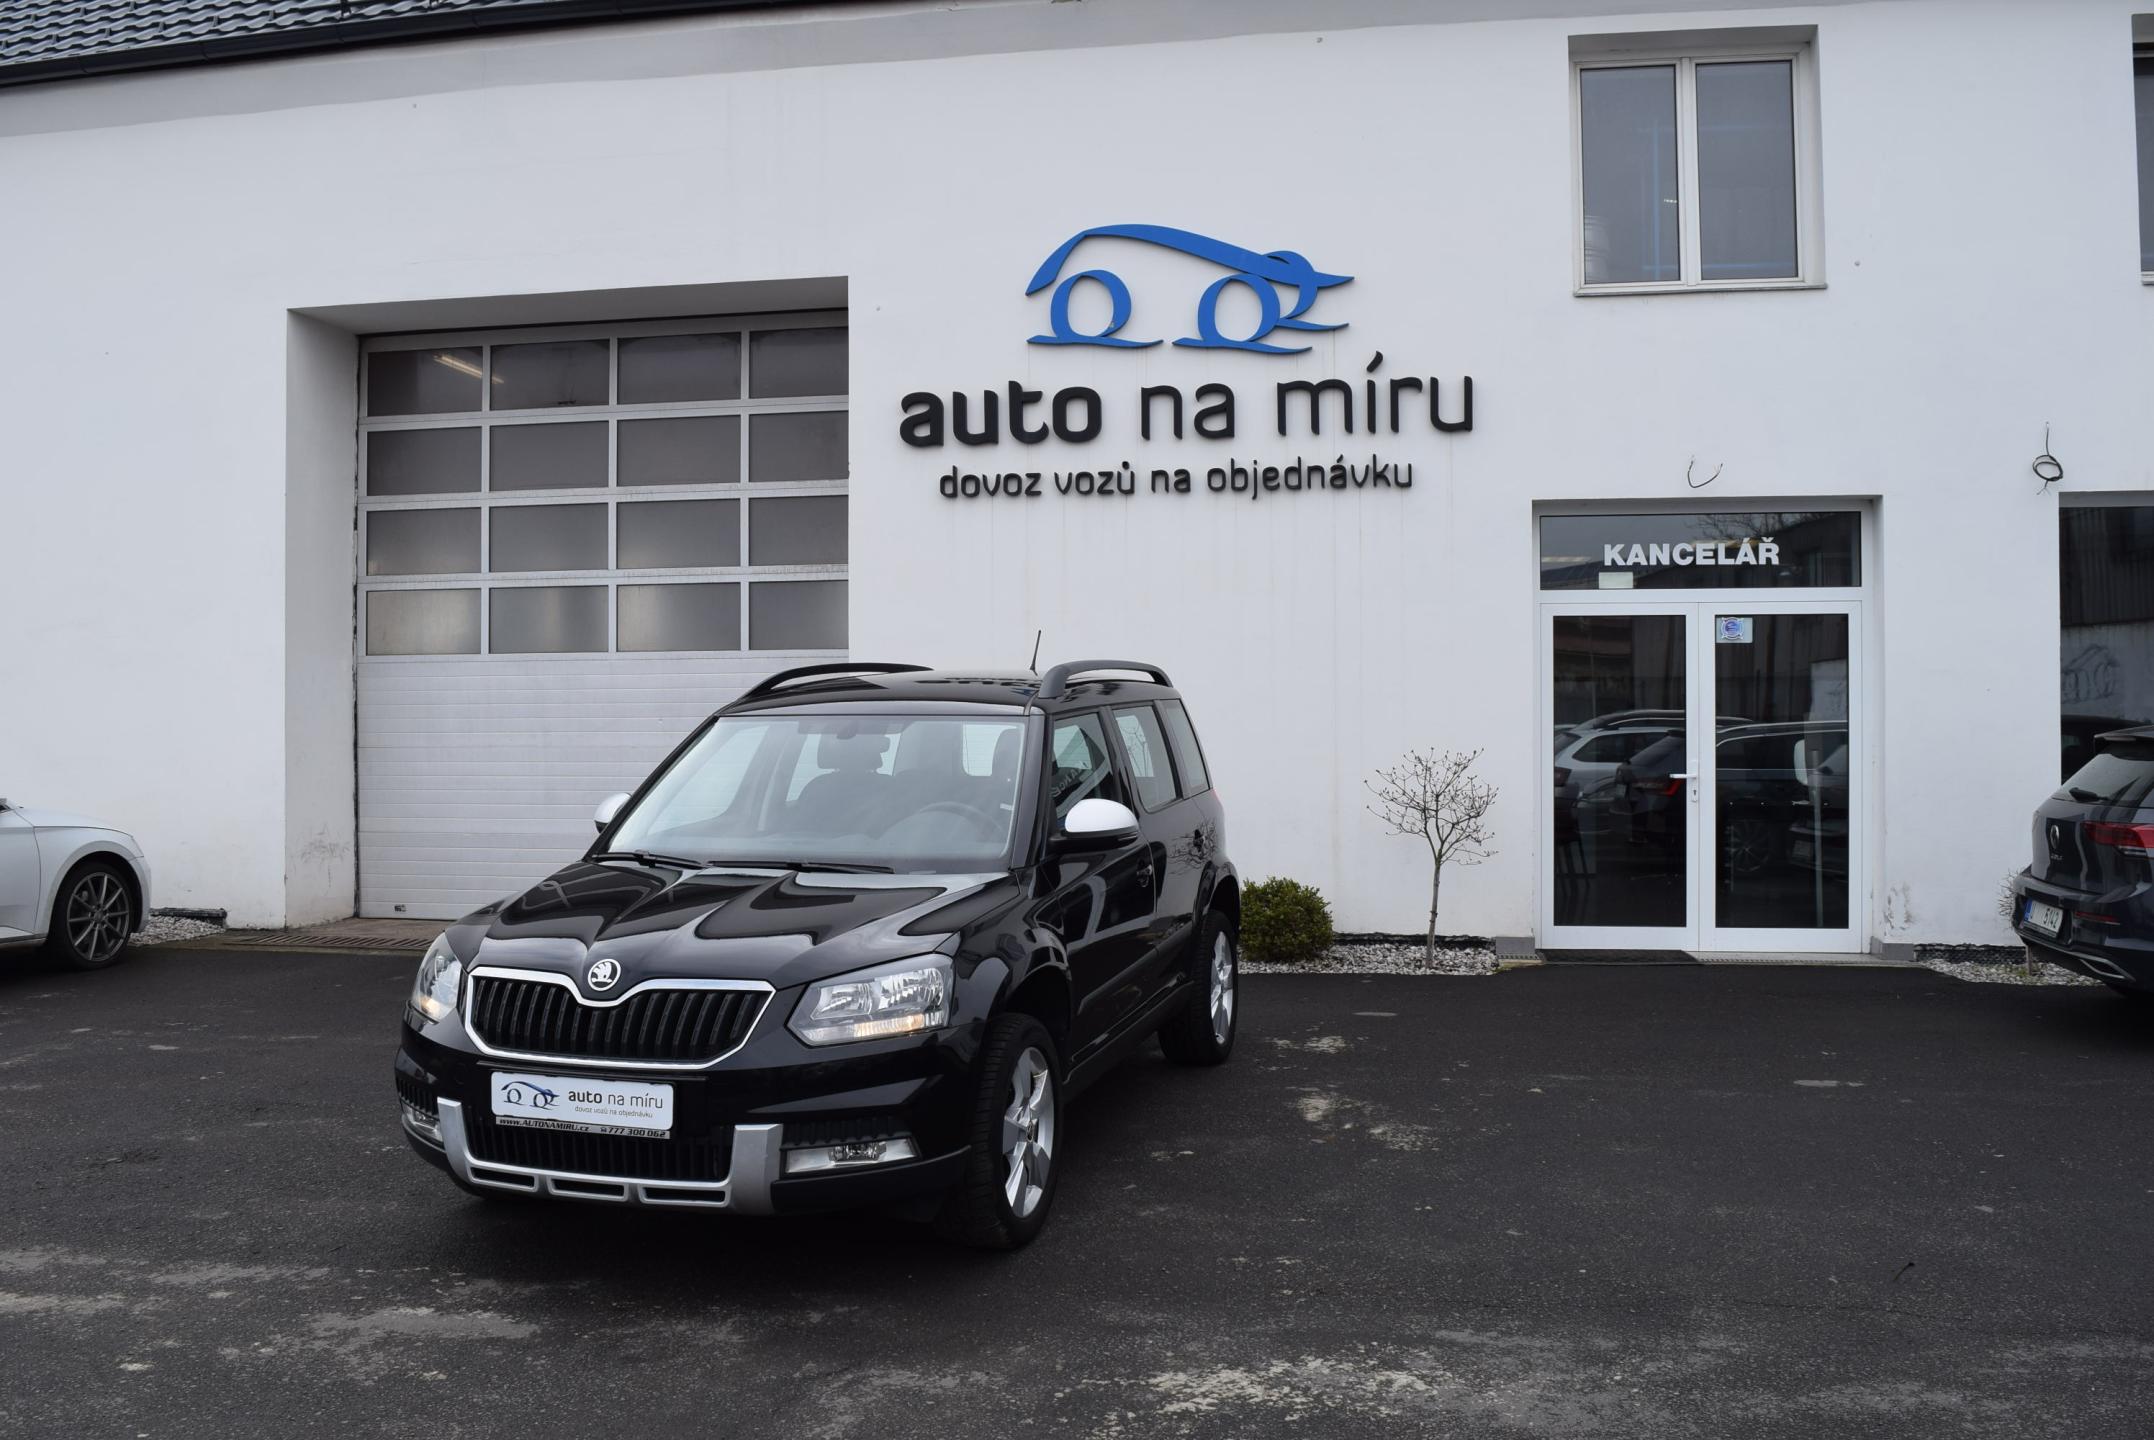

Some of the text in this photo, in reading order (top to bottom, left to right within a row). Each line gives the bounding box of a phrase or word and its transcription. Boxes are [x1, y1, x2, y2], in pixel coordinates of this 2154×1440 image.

[900, 351, 1473, 448] auto na míru
[940, 454, 1413, 500] dovoz vozů na objednávku
[1604, 537, 1779, 566] KANCELÁŘ
[568, 1091, 663, 1109] auto na míru
